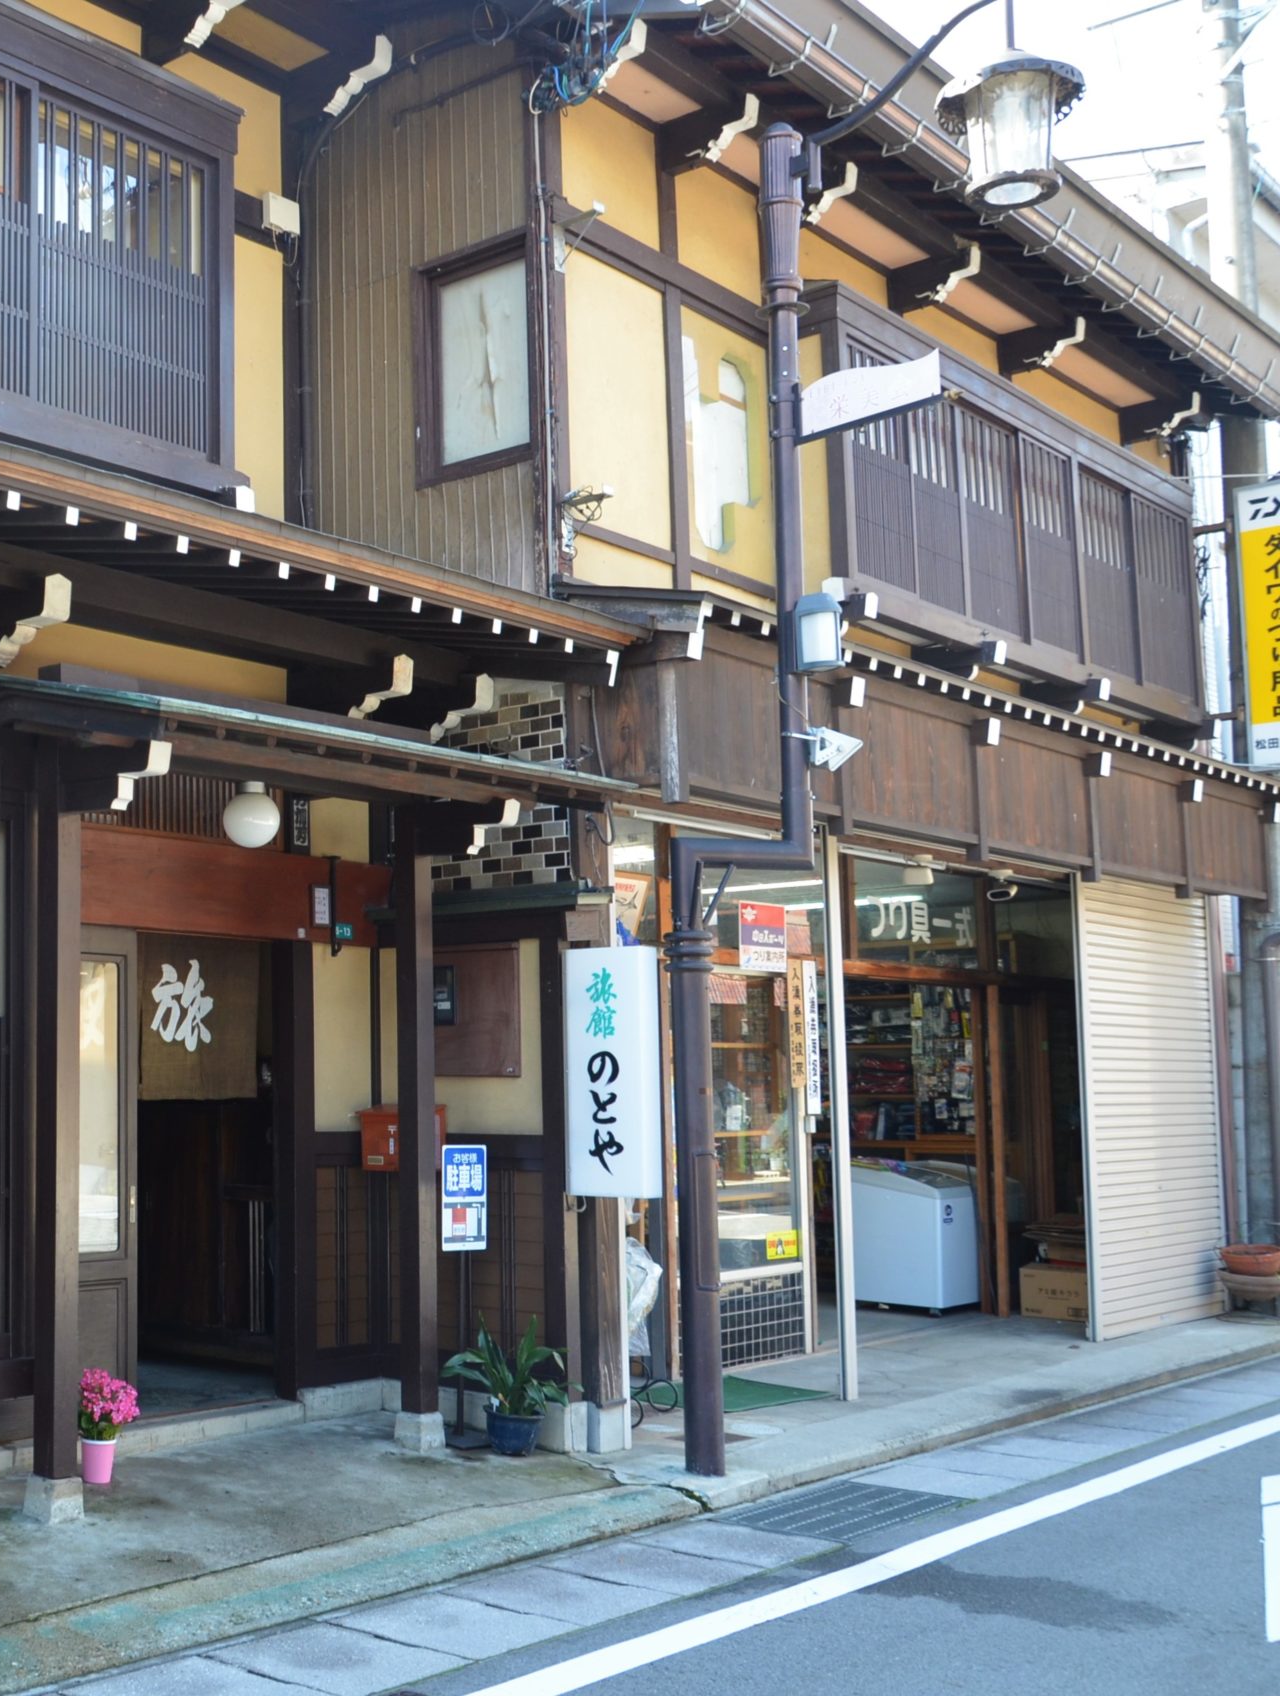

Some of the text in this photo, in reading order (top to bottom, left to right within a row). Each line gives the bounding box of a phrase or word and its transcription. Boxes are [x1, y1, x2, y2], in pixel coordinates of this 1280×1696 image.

[866, 896, 974, 948] つり具一式
[150, 959, 214, 1052] 旅
[585, 967, 624, 1175] 旅館 のとや
[446, 1164, 483, 1192] 駐車場
[452, 1153, 478, 1163] お客様
